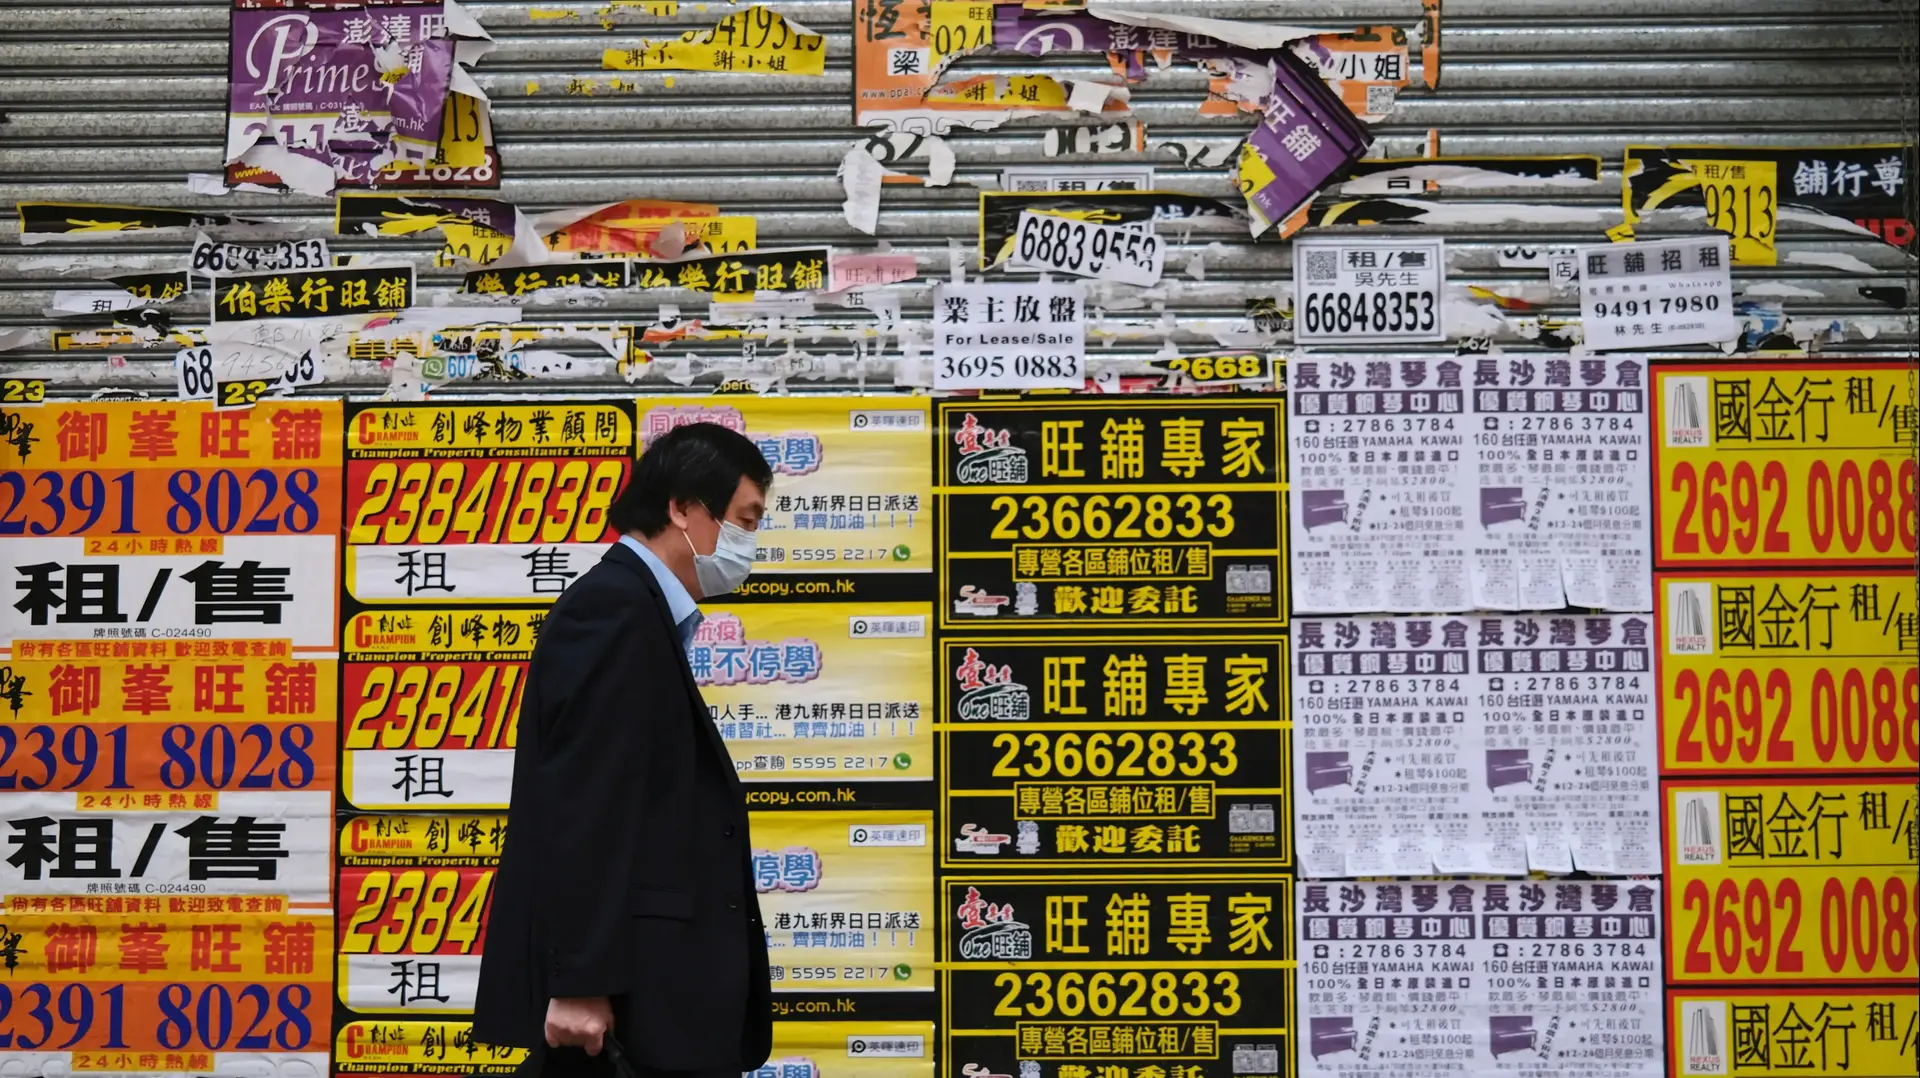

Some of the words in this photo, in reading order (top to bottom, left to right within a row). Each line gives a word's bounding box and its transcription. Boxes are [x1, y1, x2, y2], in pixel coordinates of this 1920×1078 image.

[714, 50, 787, 71] 謝小姐
[893, 50, 919, 75] 梁
[1340, 53, 1401, 80] 小姐
[1348, 251, 1427, 269] 租/售
[1588, 247, 1720, 275] 旺舖招租
[1355, 272, 1419, 288] 吳先生
[220, 277, 407, 317] 伯樂行旺舖
[943, 295, 1076, 324] 業主放盤
[1594, 300, 1651, 318] 9491
[1660, 295, 1719, 315] 7980
[946, 334, 972, 346] For
[980, 333, 1074, 346] Lease/Sale
[1615, 323, 1662, 337] 林先生
[942, 356, 1005, 379] 3695
[1015, 356, 1077, 379] 0883
[1294, 361, 1462, 389] 長沙灣琴倉
[1474, 360, 1642, 387] 長沙灣琴倉
[4, 380, 45, 401] 23
[1522, 418, 1573, 430] 2786
[1582, 417, 1633, 430] 3784
[1713, 376, 1834, 443] 國金行
[56, 409, 323, 462] 御峯旺舖
[431, 410, 617, 445] 創峰物業顧問
[1343, 420, 1394, 432] 2786
[1403, 419, 1454, 432] 3784
[352, 449, 419, 458] Champion
[424, 448, 483, 458] Property
[489, 447, 569, 456] Consultants
[573, 446, 627, 456] Limited
[1042, 417, 1265, 479] 旺舖專家
[1362, 436, 1413, 446] YAMAHA
[1421, 435, 1463, 446] KAWAI
[1672, 436, 1702, 444] REALTY
[0, 469, 140, 535] 2391
[167, 468, 319, 534] 8028
[348, 460, 623, 545] 23841838
[776, 495, 919, 512] 港九新界日日派送
[1671, 461, 1790, 554] 2692
[990, 494, 1234, 540] 23662833
[90, 538, 218, 554] 24小時熱線
[792, 549, 836, 560] 5595
[843, 549, 887, 560] 2217
[13, 560, 294, 625] 租/售
[1054, 585, 1198, 614] 歡迎委託
[1717, 583, 1840, 650] 國金行
[94, 627, 146, 638] 牌照號碼
[152, 627, 211, 638] C-024490
[1298, 620, 1468, 649] 長沙灣琴倉
[1478, 618, 1647, 646] 長沙灣琴倉
[20, 641, 167, 658] 尚有各區旺舖資料
[175, 640, 286, 657] 歡迎致電查詢
[348, 653, 416, 662] Champion
[420, 652, 481, 662] Property
[49, 662, 317, 716] 御峯旺舖
[1043, 653, 1269, 716] 旺舖專家
[1347, 680, 1399, 693] 2786
[1408, 679, 1459, 692] 3784
[1527, 678, 1579, 690] 2786
[1588, 677, 1640, 690] 3784
[776, 702, 919, 720] 港九新界日日派送
[1674, 668, 1794, 763] 2692
[160, 723, 314, 790] 8028
[792, 757, 836, 769] 5595
[844, 756, 888, 769] 2217
[992, 732, 1237, 777] 23662833
[392, 755, 454, 802] 租
[83, 794, 212, 809] 24小時熱線
[1056, 824, 1200, 854] 歡迎委託
[1725, 791, 1848, 860] 國金行
[6, 815, 289, 881] 租/售
[87, 883, 140, 894] 牌照號碼
[145, 883, 206, 894] C-024490
[1303, 884, 1474, 913] 長沙灣琴倉
[1483, 884, 1655, 912] 長沙灣琴倉
[12, 897, 161, 913] 尚有各區旺舖資料
[168, 897, 282, 912] 歡迎致電查詢
[341, 870, 495, 953] 2384
[774, 912, 920, 929] 港九新界日日派送
[1046, 892, 1273, 955] 旺舖專家
[1683, 878, 1803, 974] 2692
[1820, 876, 1918, 973] 008
[44, 921, 315, 975] 御峯旺舖
[1353, 944, 1404, 958] 2786
[1413, 944, 1466, 957] 3784
[1532, 943, 1584, 957] 2786
[1593, 943, 1645, 957] 3784
[388, 960, 450, 1006] 租
[994, 972, 1241, 1016] 23662833
[157, 983, 312, 1050] 8028
[1732, 1001, 1856, 1072] 國金行
[78, 1055, 210, 1069] 24小時熱線
[1690, 1063, 1720, 1071] REALTY
